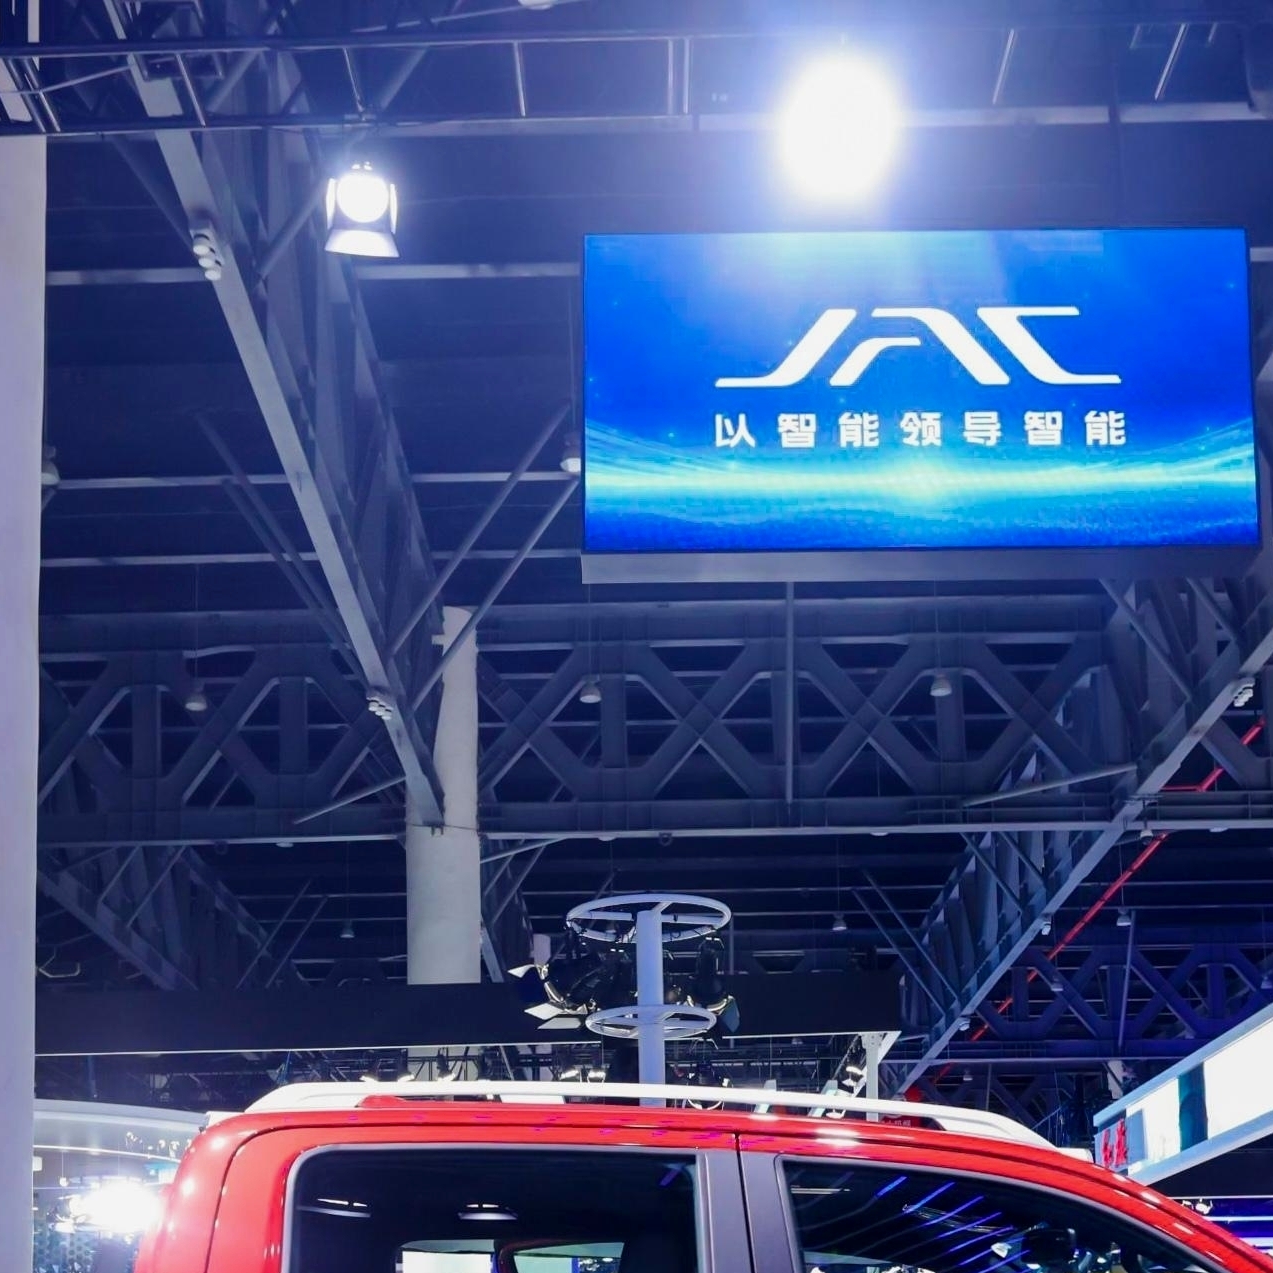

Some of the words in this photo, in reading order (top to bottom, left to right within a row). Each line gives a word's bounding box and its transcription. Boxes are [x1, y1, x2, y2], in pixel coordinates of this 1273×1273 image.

[714, 410, 1127, 449] 以智能领导智能
